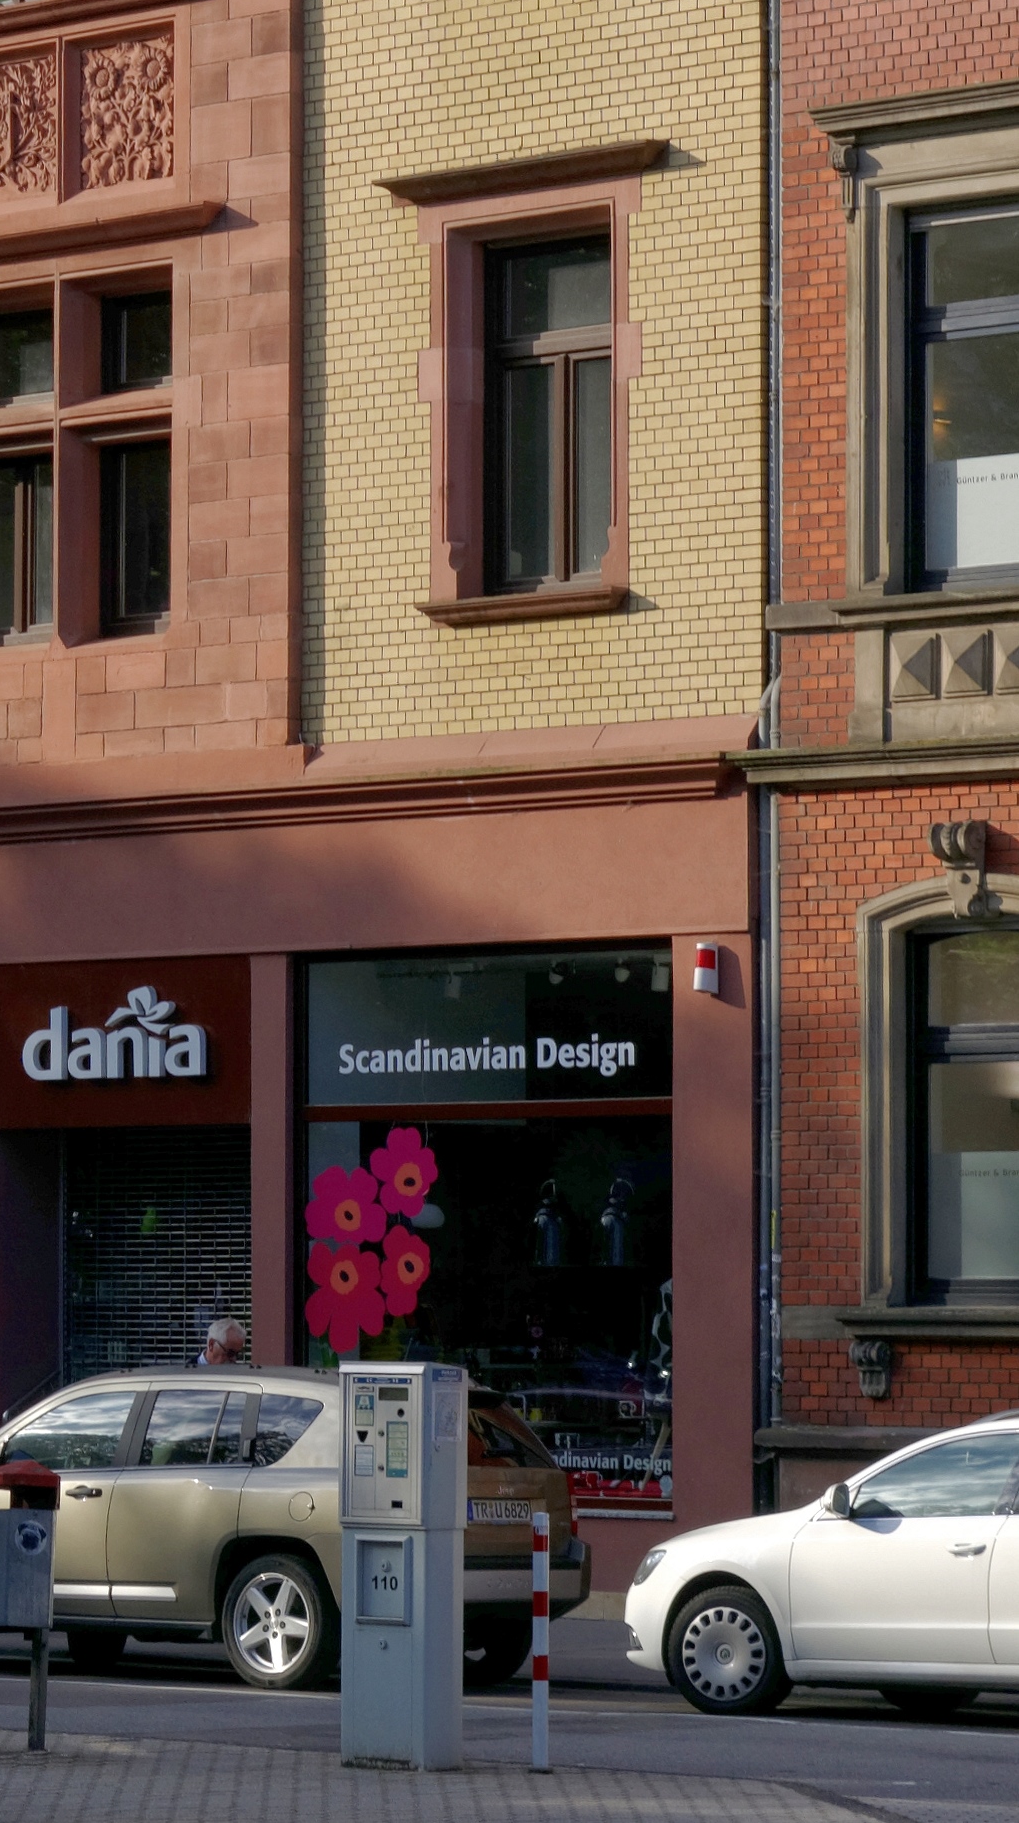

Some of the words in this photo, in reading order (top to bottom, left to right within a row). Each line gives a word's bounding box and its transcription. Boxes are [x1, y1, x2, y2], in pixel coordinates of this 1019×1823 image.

[956, 475, 988, 485] Güntzer
[21, 1004, 207, 1082] dania
[337, 1037, 526, 1075] Scandinavian
[536, 1032, 637, 1078] Design
[473, 1502, 489, 1519] TR
[504, 1502, 529, 1519] 6829
[371, 1574, 398, 1591] 110
